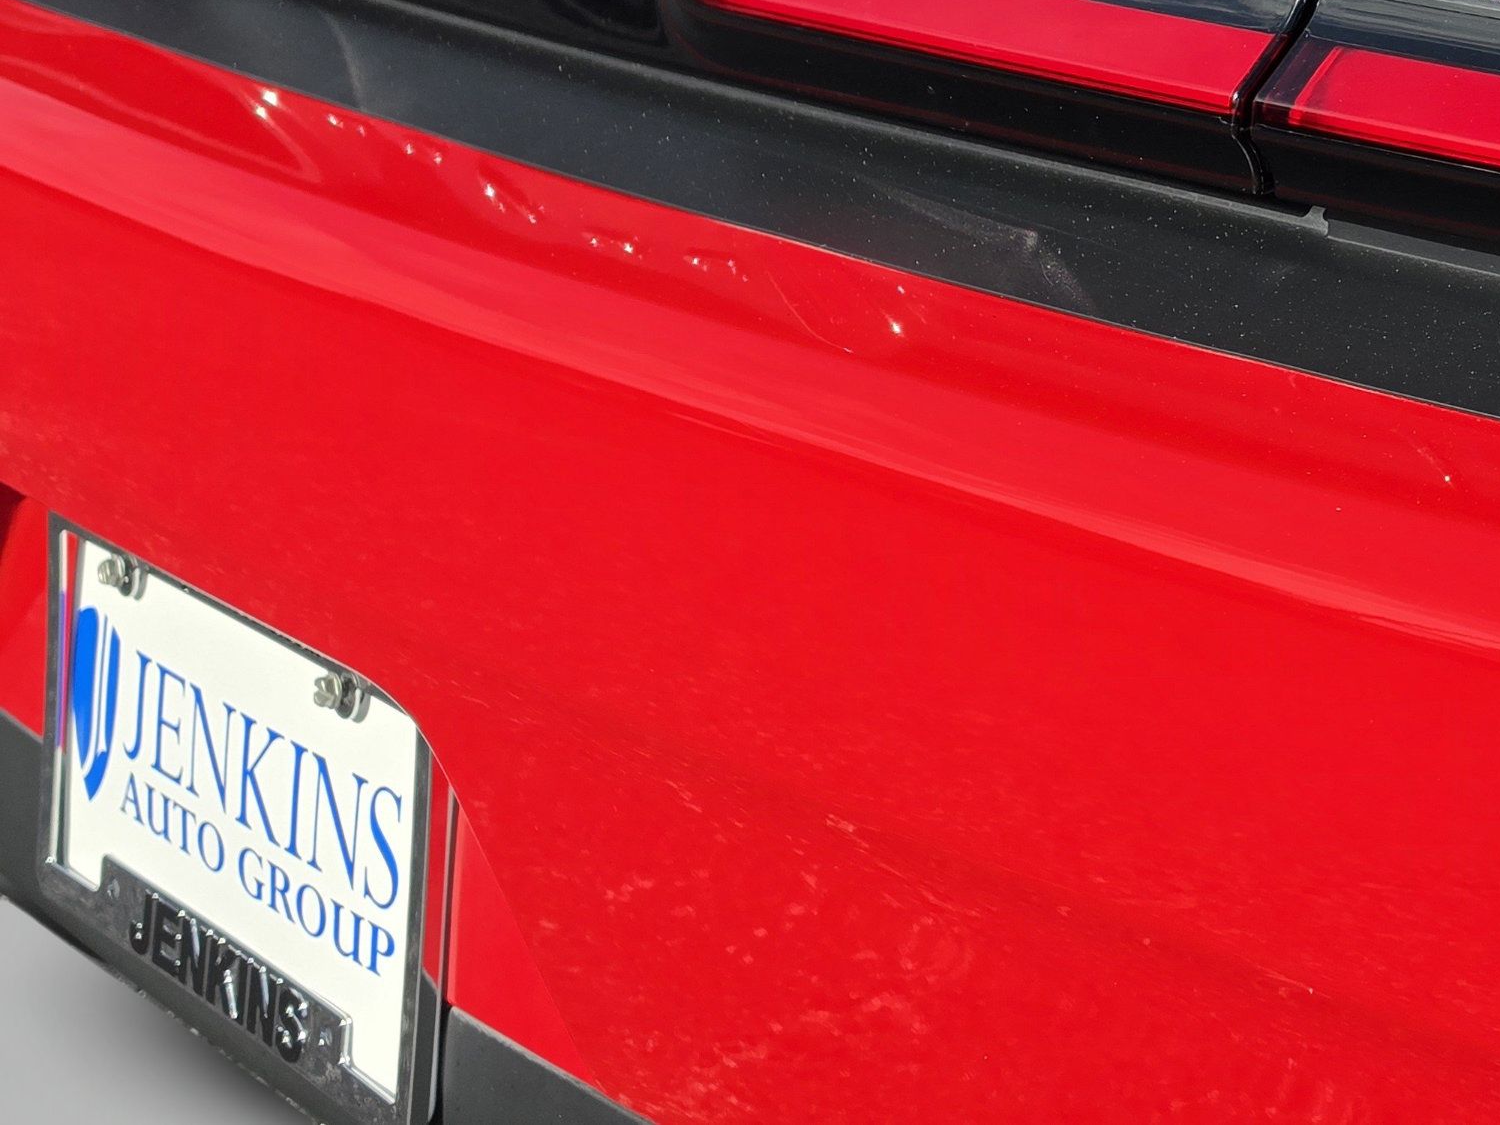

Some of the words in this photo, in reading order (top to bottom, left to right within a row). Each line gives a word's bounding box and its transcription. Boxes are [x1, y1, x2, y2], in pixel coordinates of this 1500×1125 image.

[120, 772, 225, 874] AUTO
[237, 846, 396, 977] GROUP
[122, 650, 402, 911] JENKINS
[128, 887, 311, 1065] JENKINS
